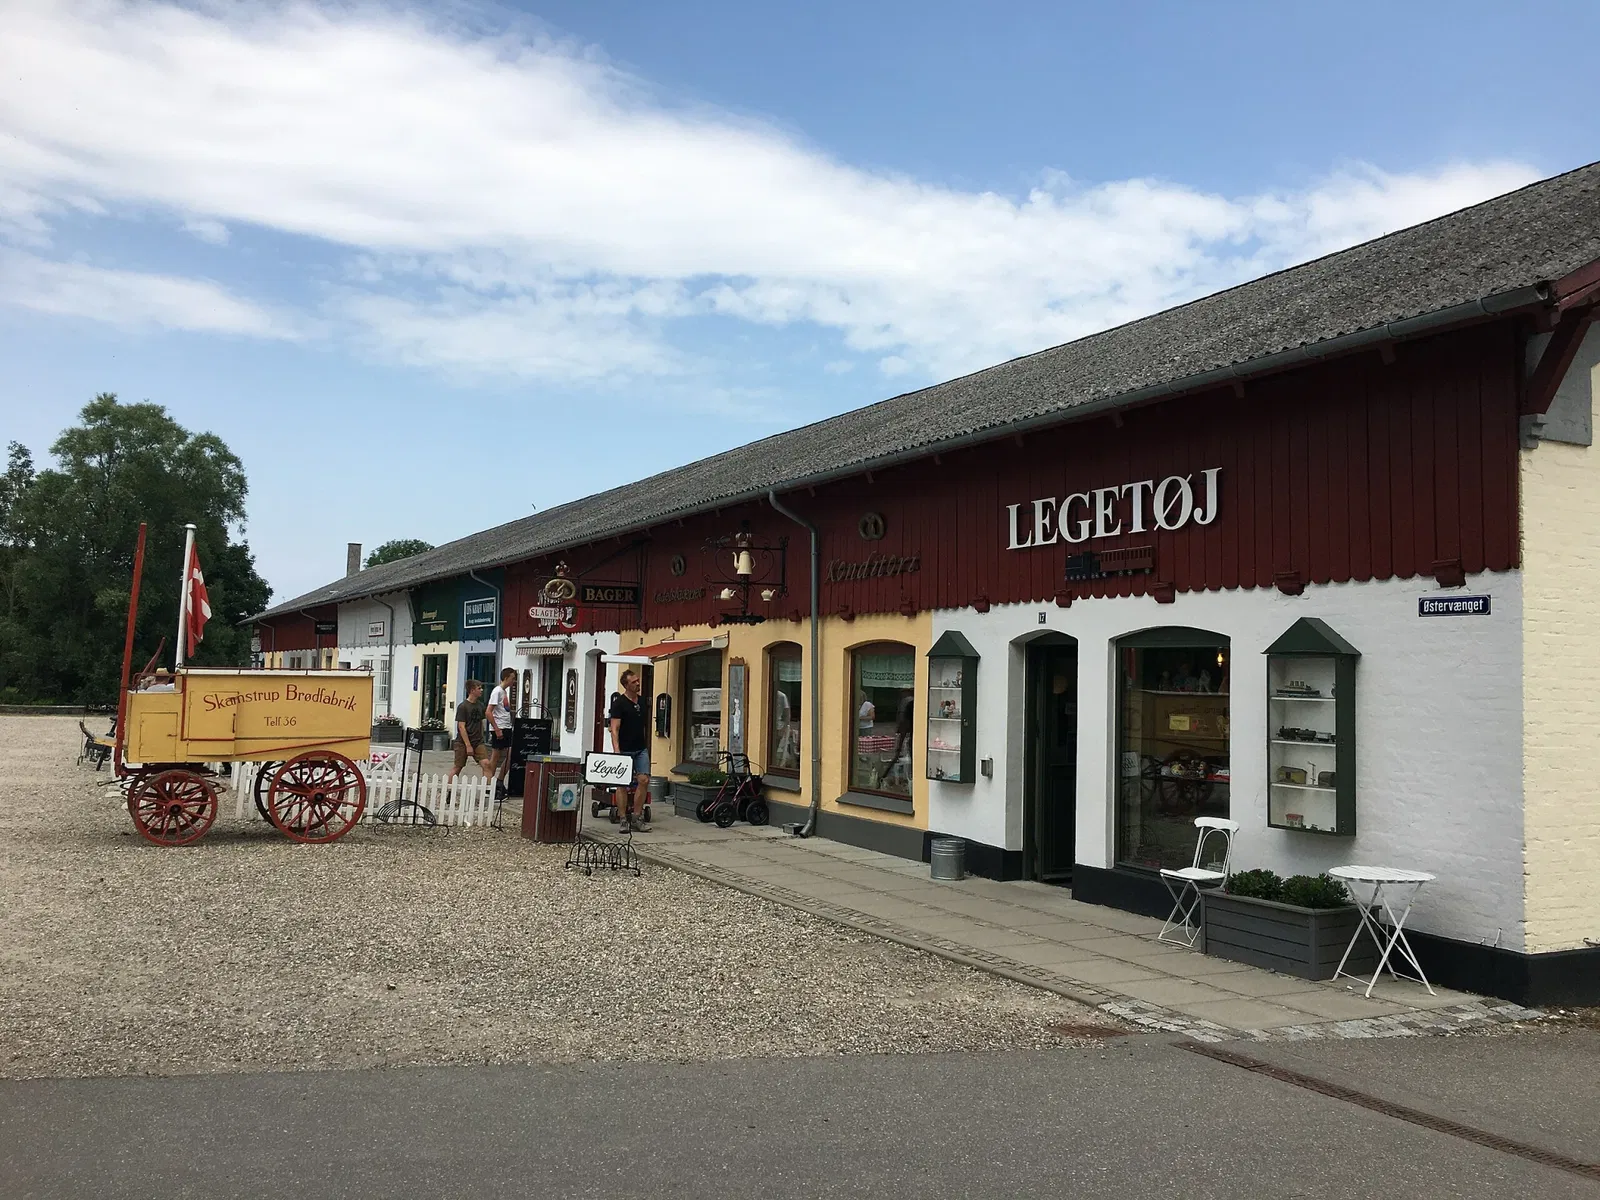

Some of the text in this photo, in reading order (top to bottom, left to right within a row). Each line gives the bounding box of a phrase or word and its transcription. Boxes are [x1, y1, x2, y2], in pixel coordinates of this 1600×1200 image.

[1005, 467, 1223, 551] LEGETØJ
[824, 549, 921, 584] Konditori
[585, 588, 634, 602] BAGER
[1423, 598, 1484, 613] Østervænget
[1039, 613, 1045, 622] 17
[203, 683, 357, 712] Skamstrup Brødfabrik
[283, 716, 297, 727] 36
[590, 760, 628, 779] Legetøj
